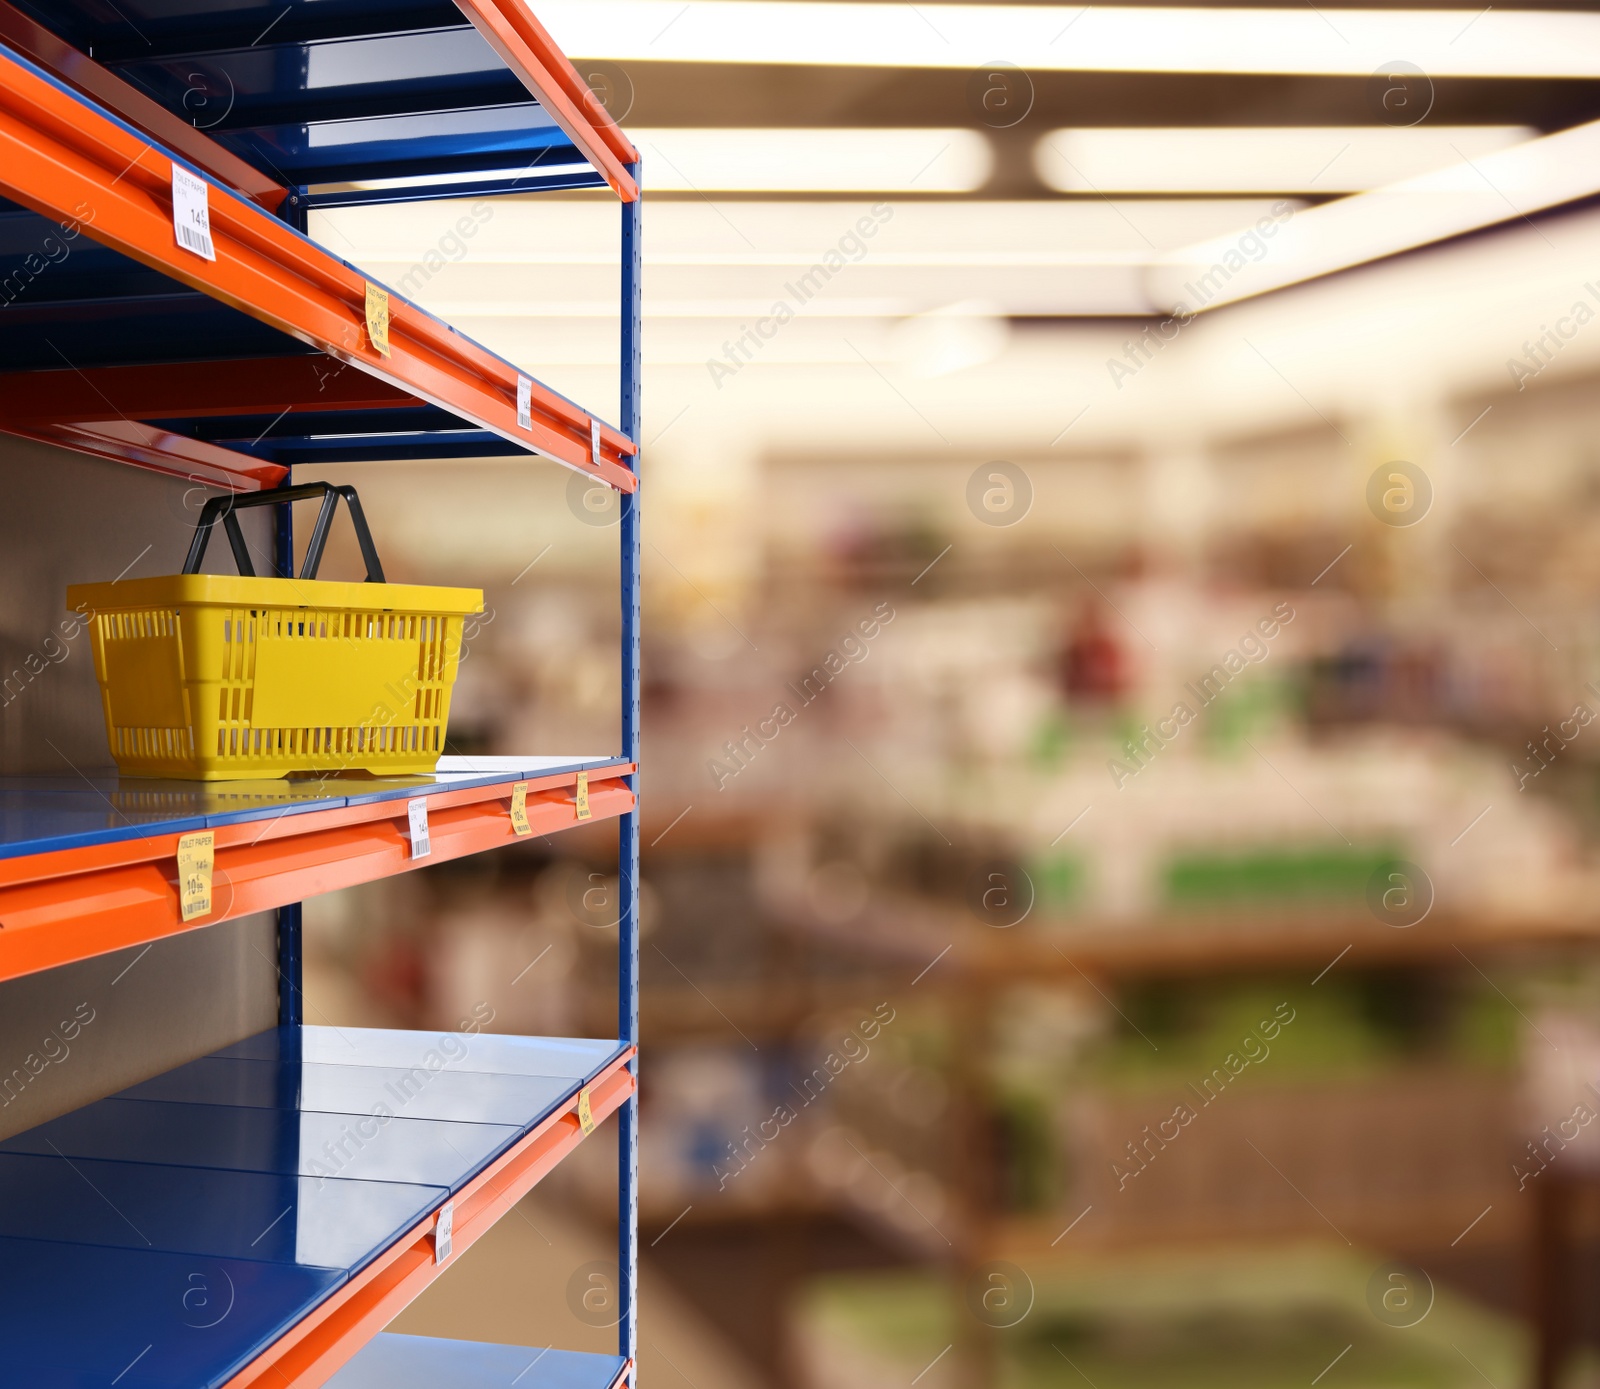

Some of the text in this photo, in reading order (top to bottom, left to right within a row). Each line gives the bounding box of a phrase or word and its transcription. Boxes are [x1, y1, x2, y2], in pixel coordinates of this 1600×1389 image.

[175, 170, 206, 196] TOILET PAPER
[181, 836, 213, 849] TOILET PAPER
